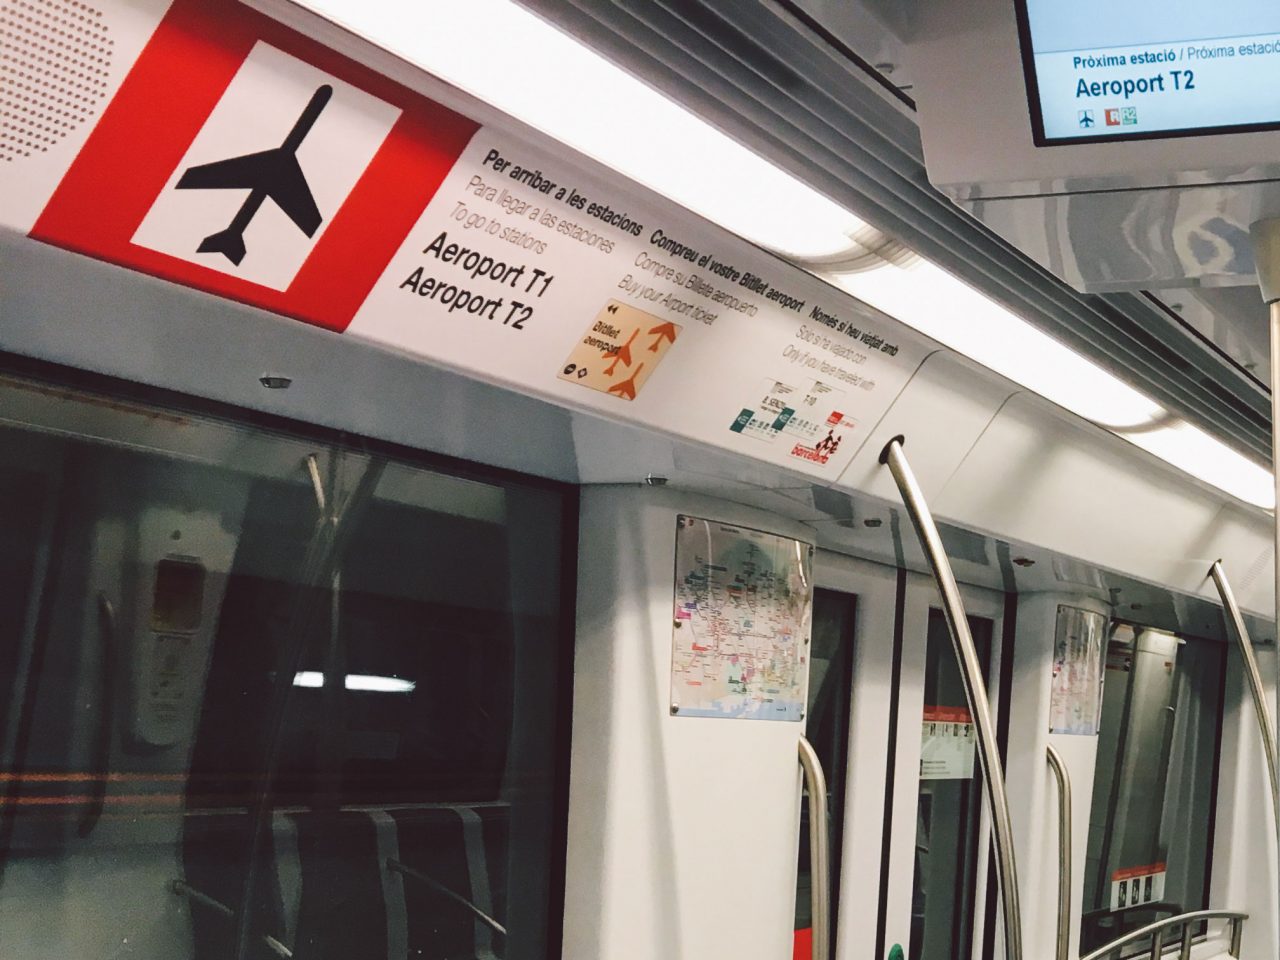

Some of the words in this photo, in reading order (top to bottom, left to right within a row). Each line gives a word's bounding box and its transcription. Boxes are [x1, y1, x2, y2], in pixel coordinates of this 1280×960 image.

[1073, 52, 1127, 69] Pròxima
[1130, 49, 1176, 65] estació
[1187, 44, 1235, 60] Próxima
[1076, 73, 1164, 99] Aeroport
[1170, 69, 1196, 91] T2
[465, 174, 498, 202] Para
[496, 183, 534, 216] llegar
[529, 206, 540, 220] a
[538, 207, 559, 229] las
[556, 221, 616, 255] estaciones
[483, 149, 511, 173] Per
[509, 165, 557, 195] arribar
[554, 184, 567, 200] a
[565, 187, 588, 211] les
[586, 202, 644, 237] estacions
[449, 201, 471, 224] To
[463, 212, 487, 230] go
[484, 217, 501, 236] to
[499, 226, 548, 256] stations
[423, 231, 526, 289] Aeroport
[524, 268, 556, 298] T1
[634, 251, 675, 280] Compre
[711, 289, 759, 318] aeropuerto
[649, 229, 699, 263] Compreu
[697, 254, 713, 268] el
[708, 259, 741, 283] vostre
[738, 272, 769, 296] Bitllet
[765, 287, 805, 314] aeroport
[400, 266, 503, 321] Aeroport
[503, 299, 534, 330] T2
[617, 274, 641, 296] Buy
[635, 286, 664, 303] your
[661, 292, 694, 317] Airport
[583, 334, 622, 356] aeroport
[808, 305, 839, 329] Només
[836, 320, 849, 333] si
[844, 322, 861, 340] heu
[880, 342, 899, 357] amb
